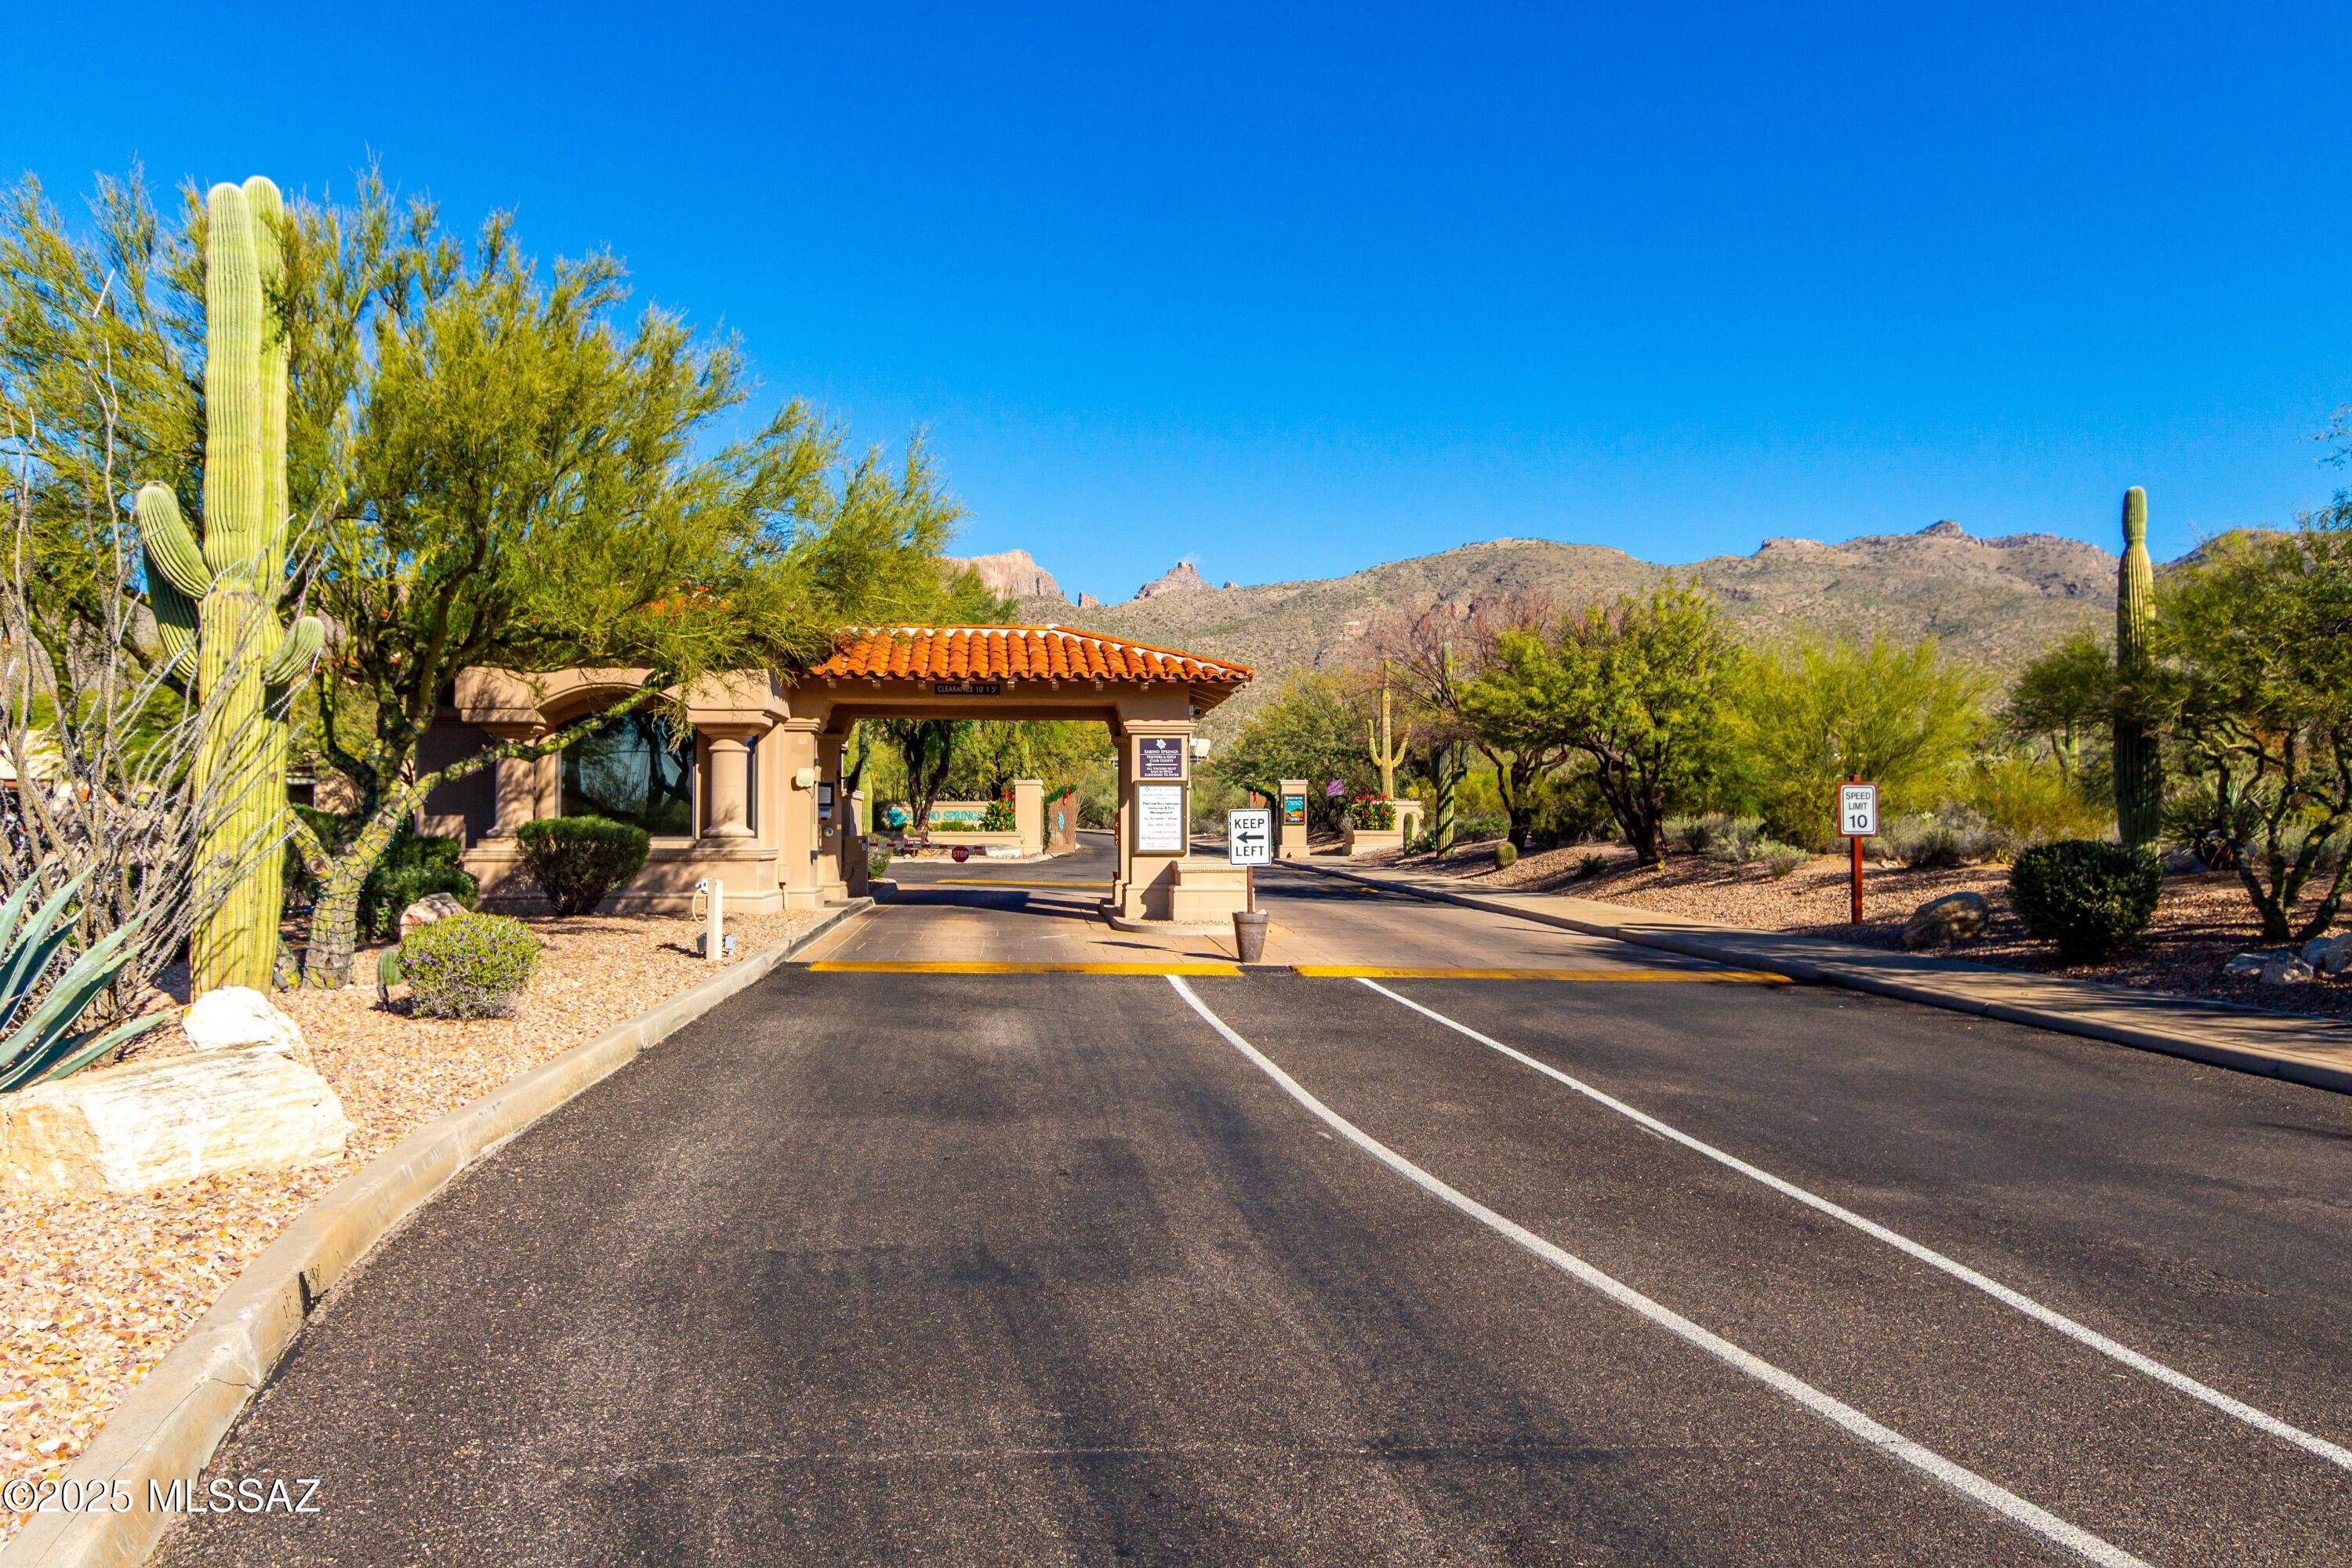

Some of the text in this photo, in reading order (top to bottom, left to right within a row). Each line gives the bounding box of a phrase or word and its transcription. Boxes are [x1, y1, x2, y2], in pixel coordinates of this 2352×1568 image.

[906, 811, 984, 820] SNO SPRINGS
[1234, 818, 1265, 829] KEEP
[1849, 815, 1867, 828] 10
[1236, 846, 1265, 856] LEFT
